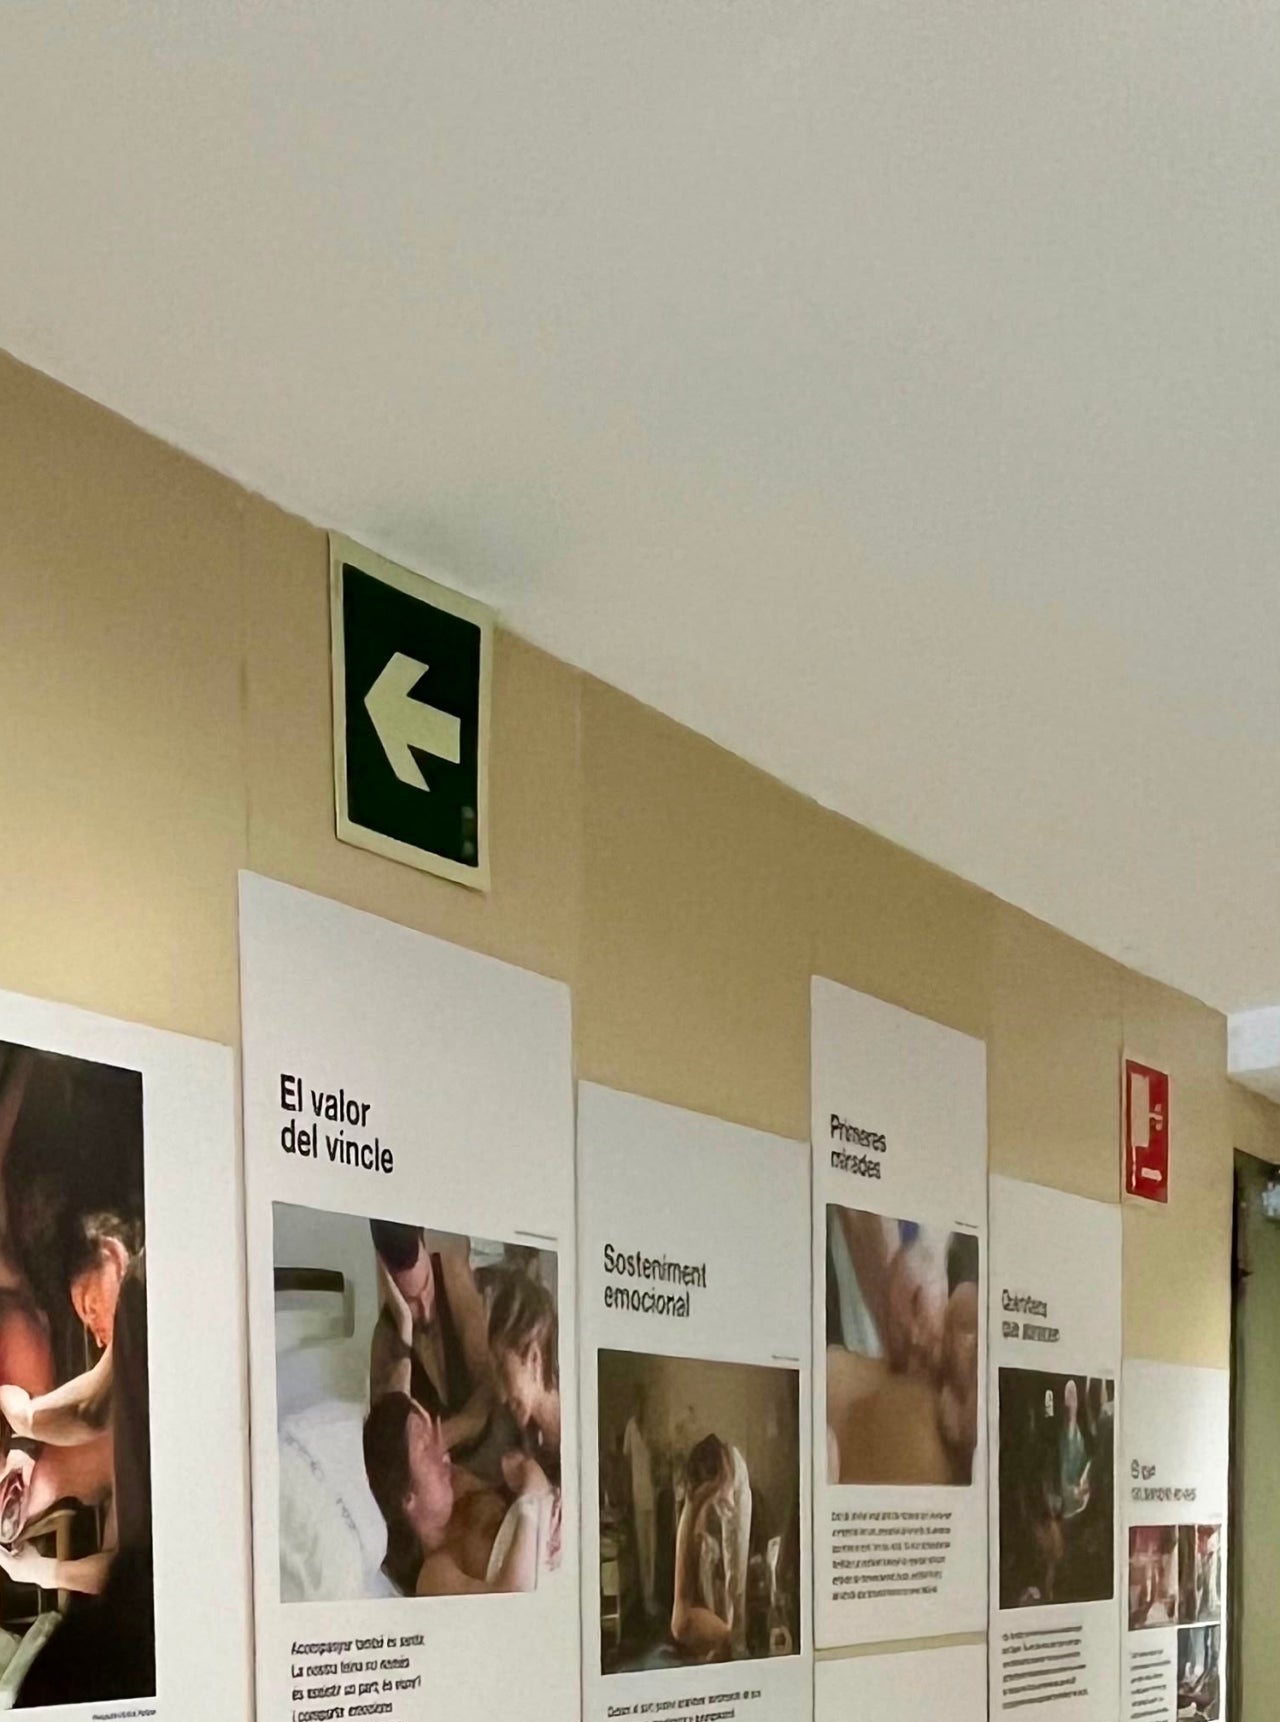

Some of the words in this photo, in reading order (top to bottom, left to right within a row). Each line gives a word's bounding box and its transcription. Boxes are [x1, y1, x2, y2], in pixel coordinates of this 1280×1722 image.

[280, 1074, 302, 1112] El
[311, 1089, 370, 1128] valor
[281, 1118, 318, 1158] del
[325, 1130, 393, 1174] vincle
[604, 1244, 706, 1288] Sosteniment
[604, 1286, 690, 1317] emocional
